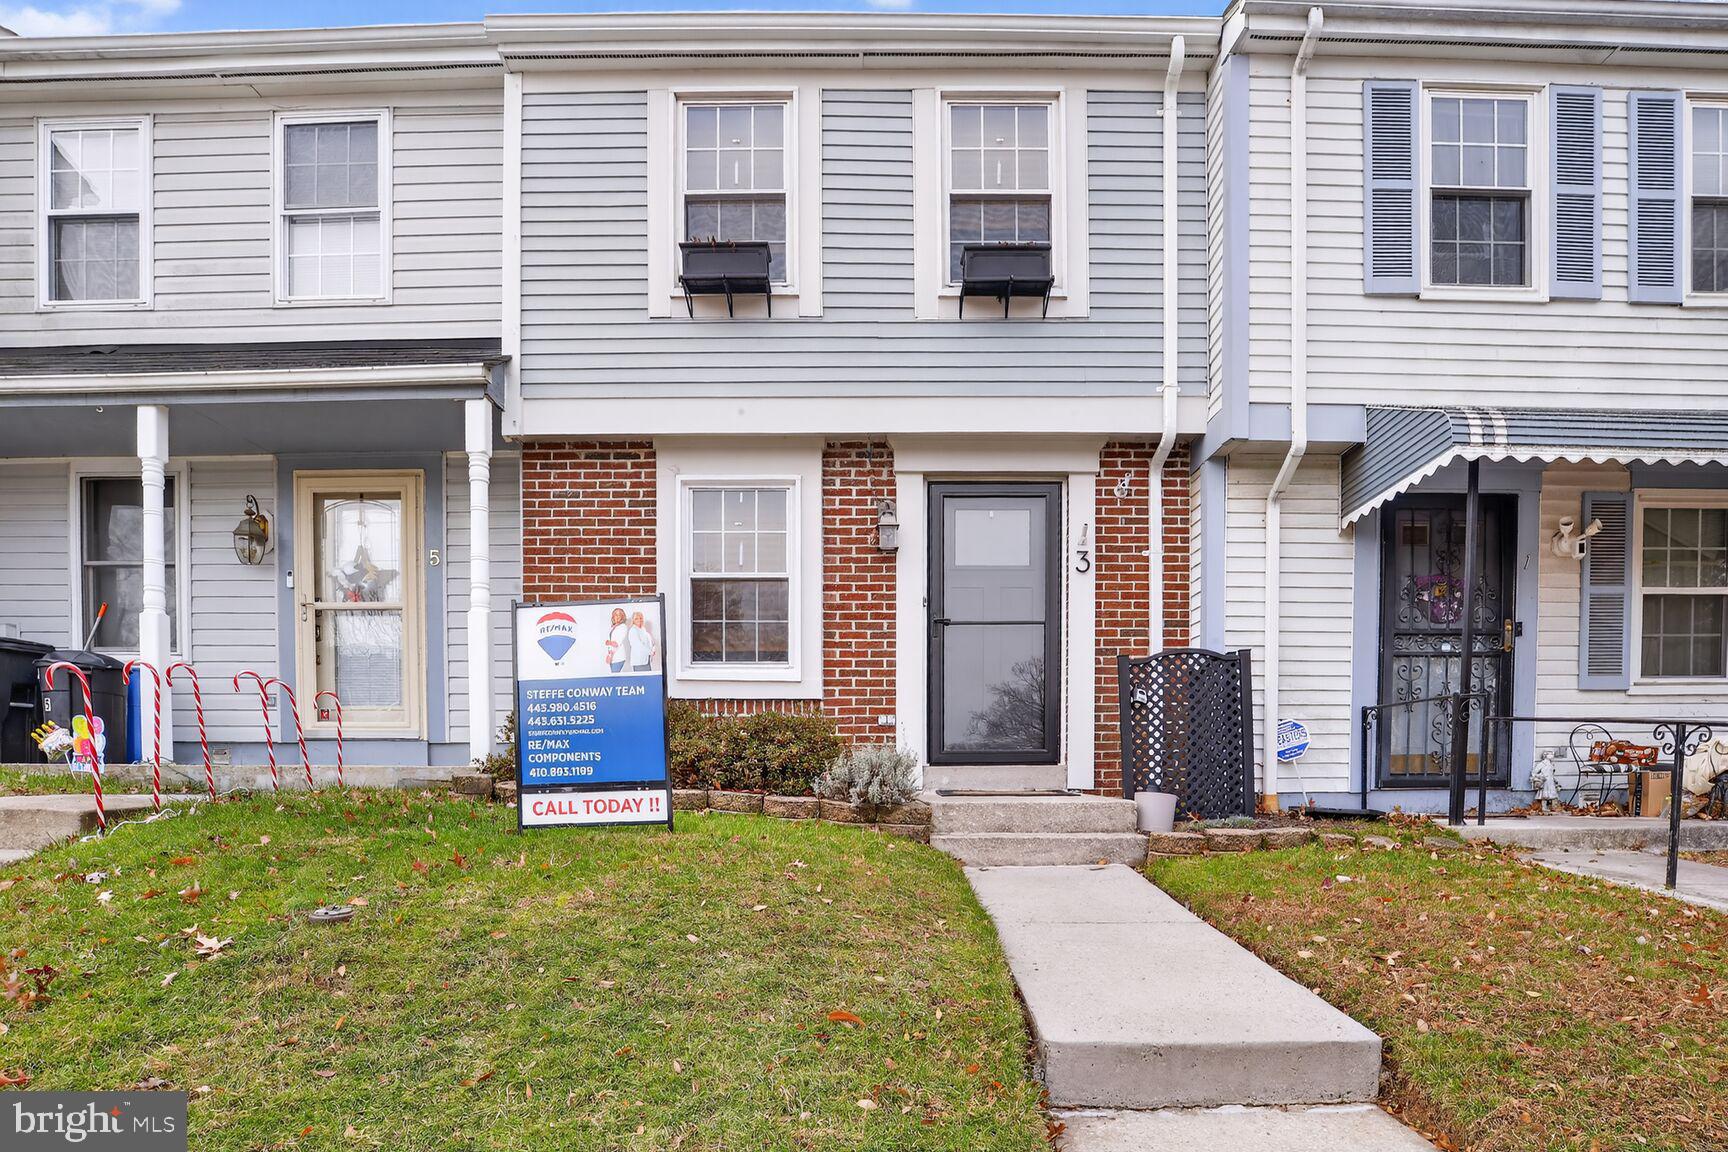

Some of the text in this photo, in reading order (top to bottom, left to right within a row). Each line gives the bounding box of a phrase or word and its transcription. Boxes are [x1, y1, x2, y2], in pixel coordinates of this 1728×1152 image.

[429, 549, 441, 566] 5
[539, 624, 574, 634] RE/MAX
[526, 685, 646, 700] STEFFE CONWAY TEAM
[528, 739, 570, 751] RE/MAX
[528, 752, 602, 763] COMPONENTS
[532, 799, 579, 816] CALL
[583, 798, 644, 815] TODAY
